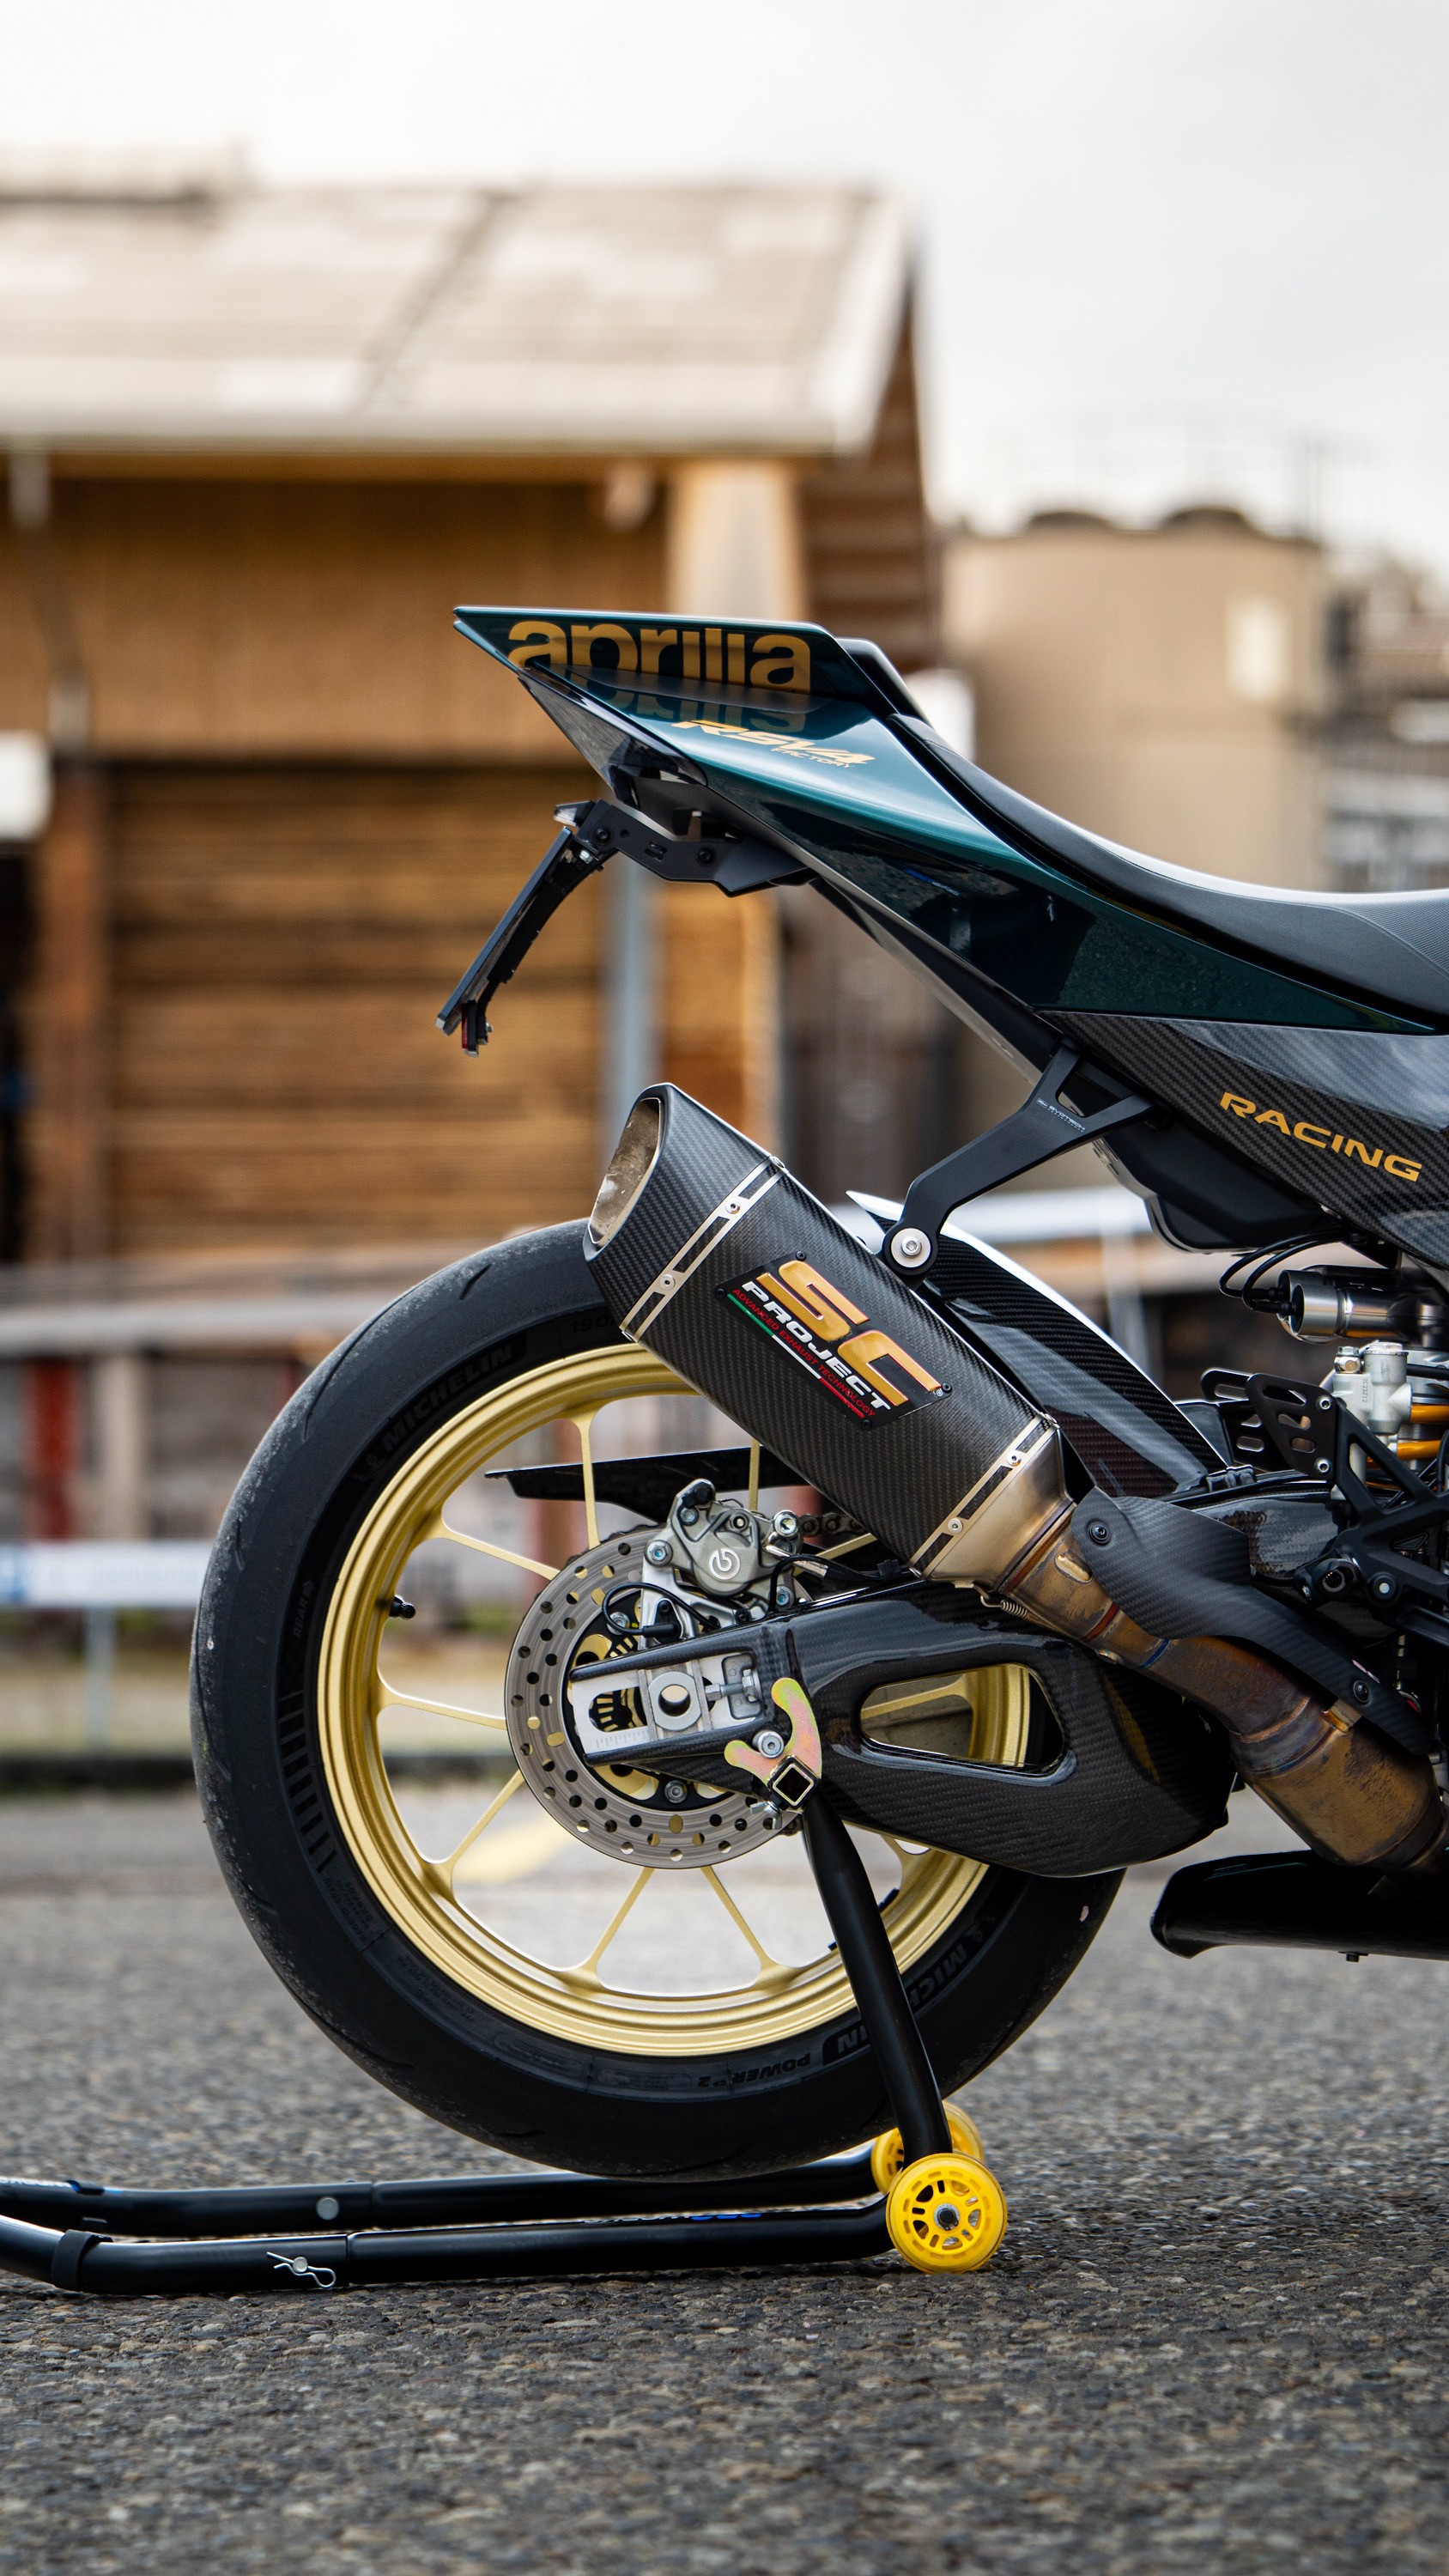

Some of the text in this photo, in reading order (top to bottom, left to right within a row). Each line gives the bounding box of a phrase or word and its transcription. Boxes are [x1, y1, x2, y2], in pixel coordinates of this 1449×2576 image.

[507, 621, 812, 696] aprilia
[1220, 1092, 1422, 1182] RACING
[732, 1289, 876, 1417] ADVANCED EXHAUST TECHNOLOGY
[742, 1280, 891, 1411] PROJECT
[380, 1343, 514, 1451] MICHELIN
[291, 1595, 310, 1638] REAR
[837, 1943, 967, 2054] MICHIN
[731, 2054, 812, 2084] POWER
